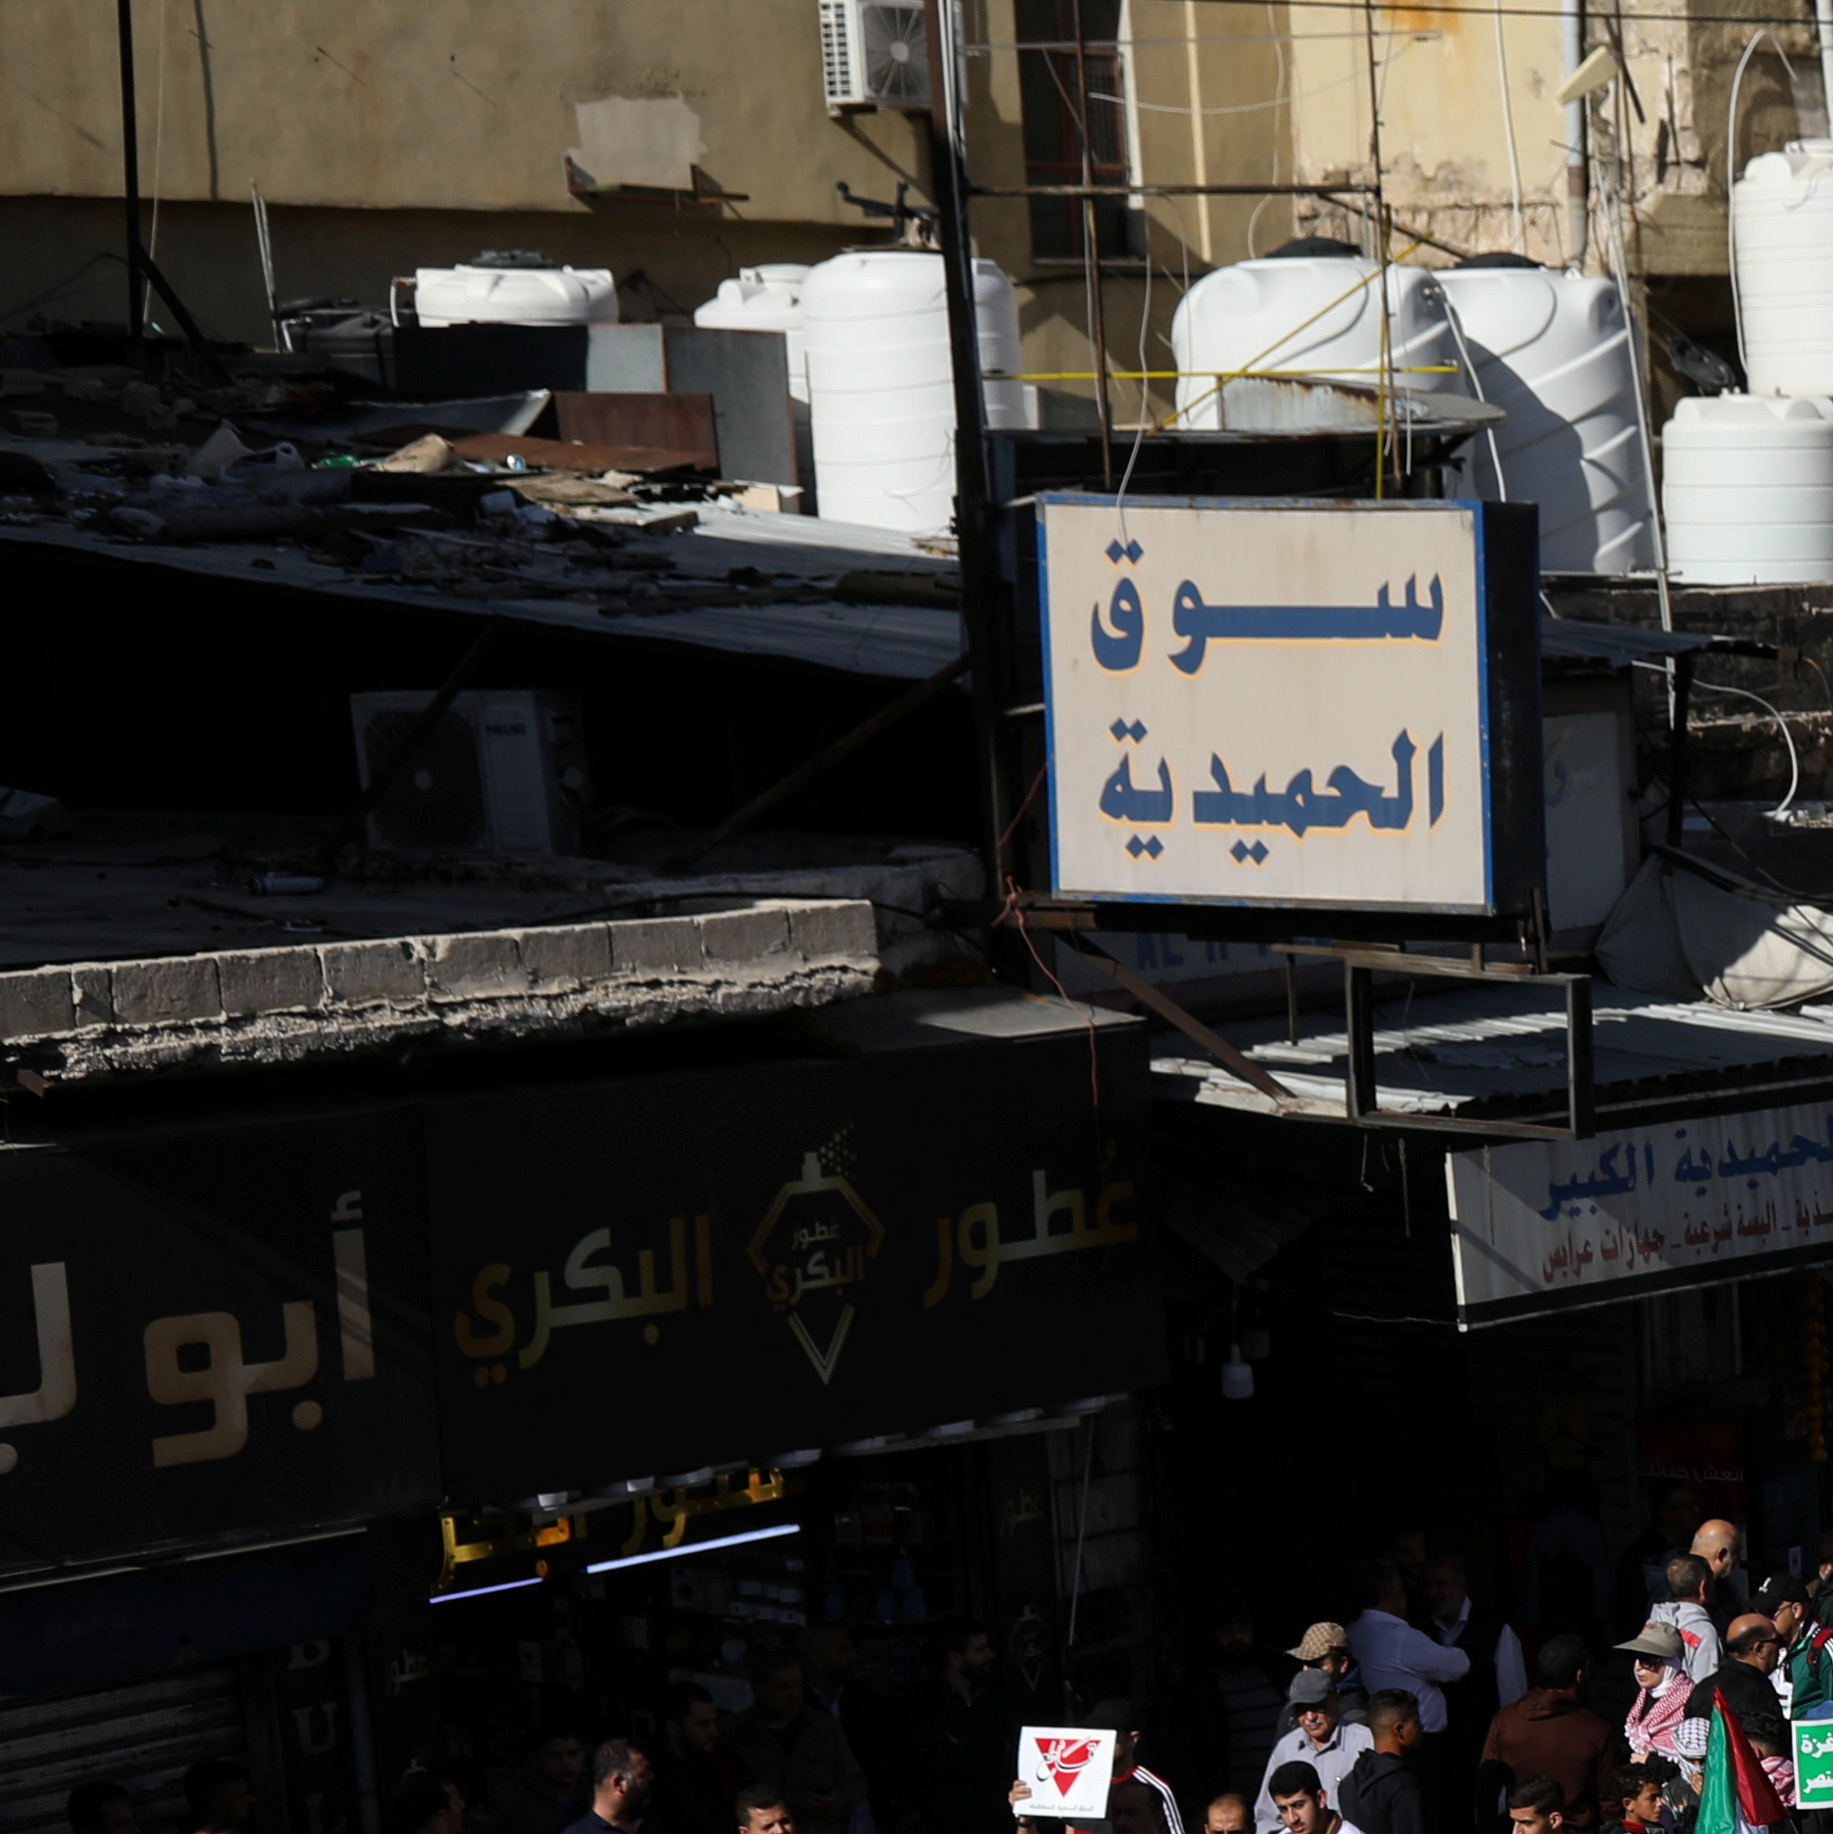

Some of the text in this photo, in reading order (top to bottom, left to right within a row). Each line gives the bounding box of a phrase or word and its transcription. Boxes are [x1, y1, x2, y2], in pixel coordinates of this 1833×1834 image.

[1091, 538, 1445, 680] سوق
[1099, 717, 1446, 868] الحميدية
[1540, 1139, 1656, 1221] الكبير
[789, 1216, 842, 1250] عطور
[1542, 1229, 1594, 1284] عرايس
[1683, 1200, 1734, 1255] شرعية
[453, 1215, 714, 1386] البكري
[764, 1231, 867, 1312] البكري
[143, 1190, 376, 1468] أبو
